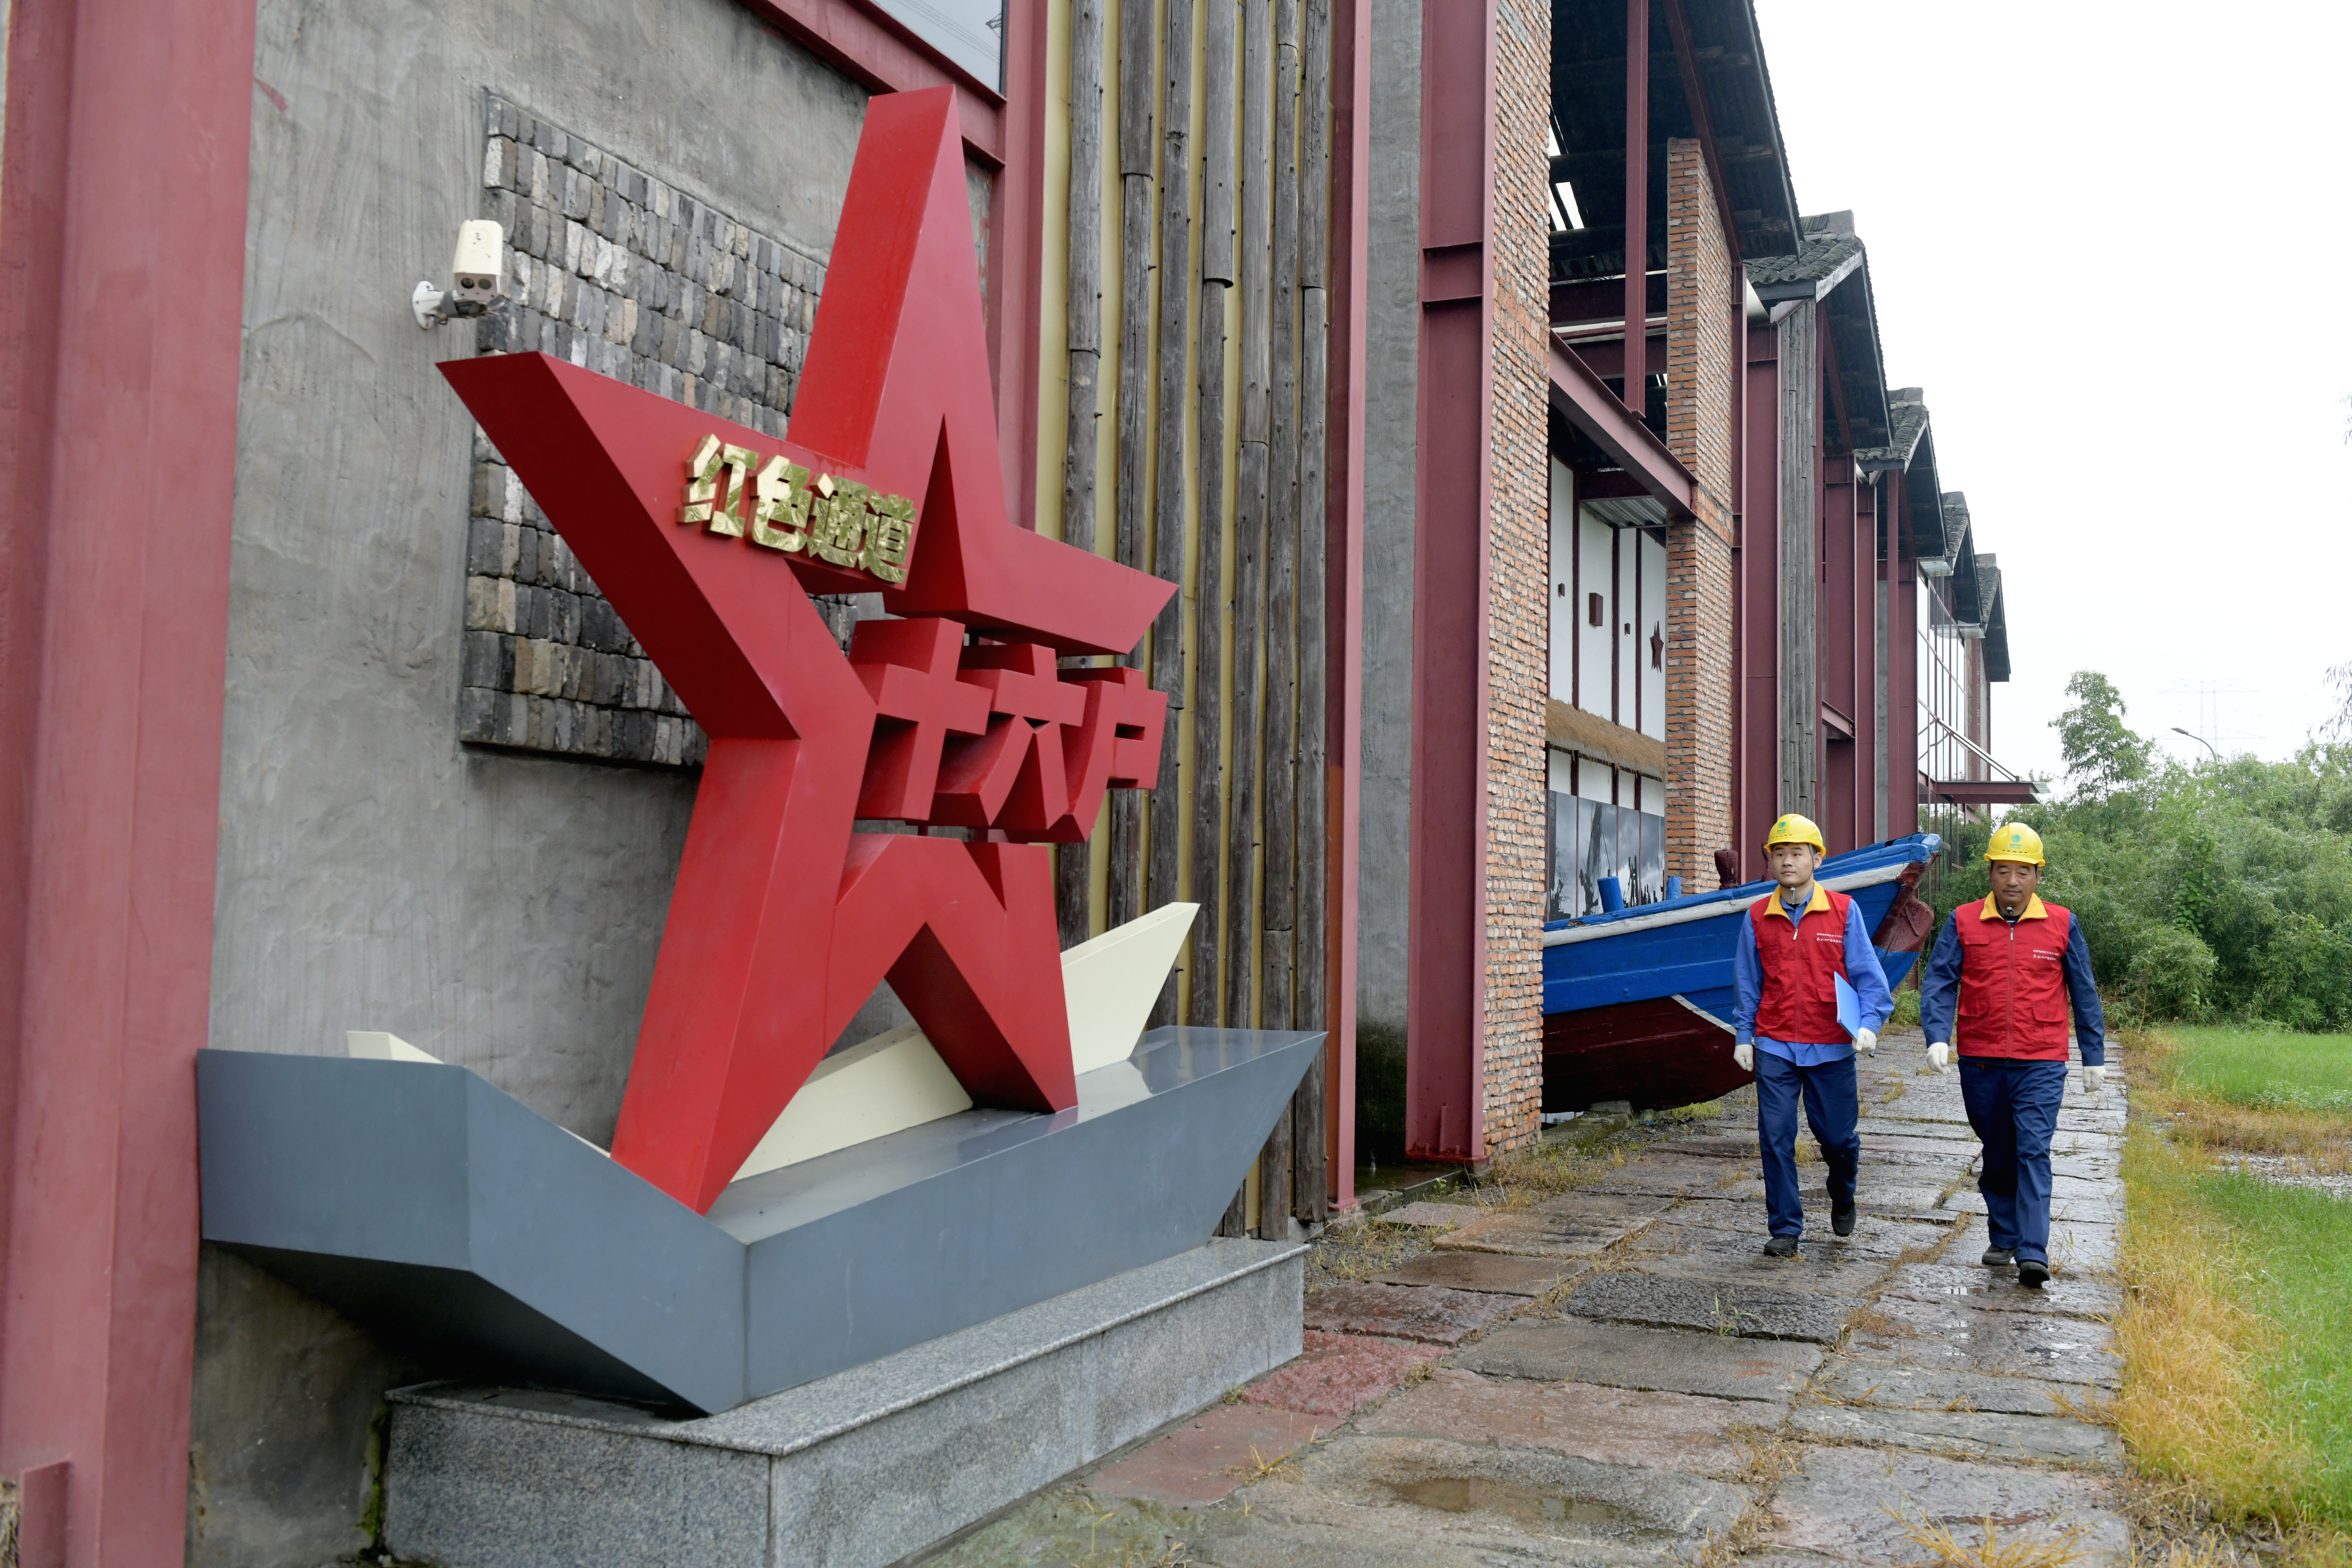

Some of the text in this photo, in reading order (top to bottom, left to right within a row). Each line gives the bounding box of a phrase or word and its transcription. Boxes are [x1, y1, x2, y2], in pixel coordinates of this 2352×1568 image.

[678, 433, 917, 583] 红色通道
[874, 618, 1168, 842] 十六户
